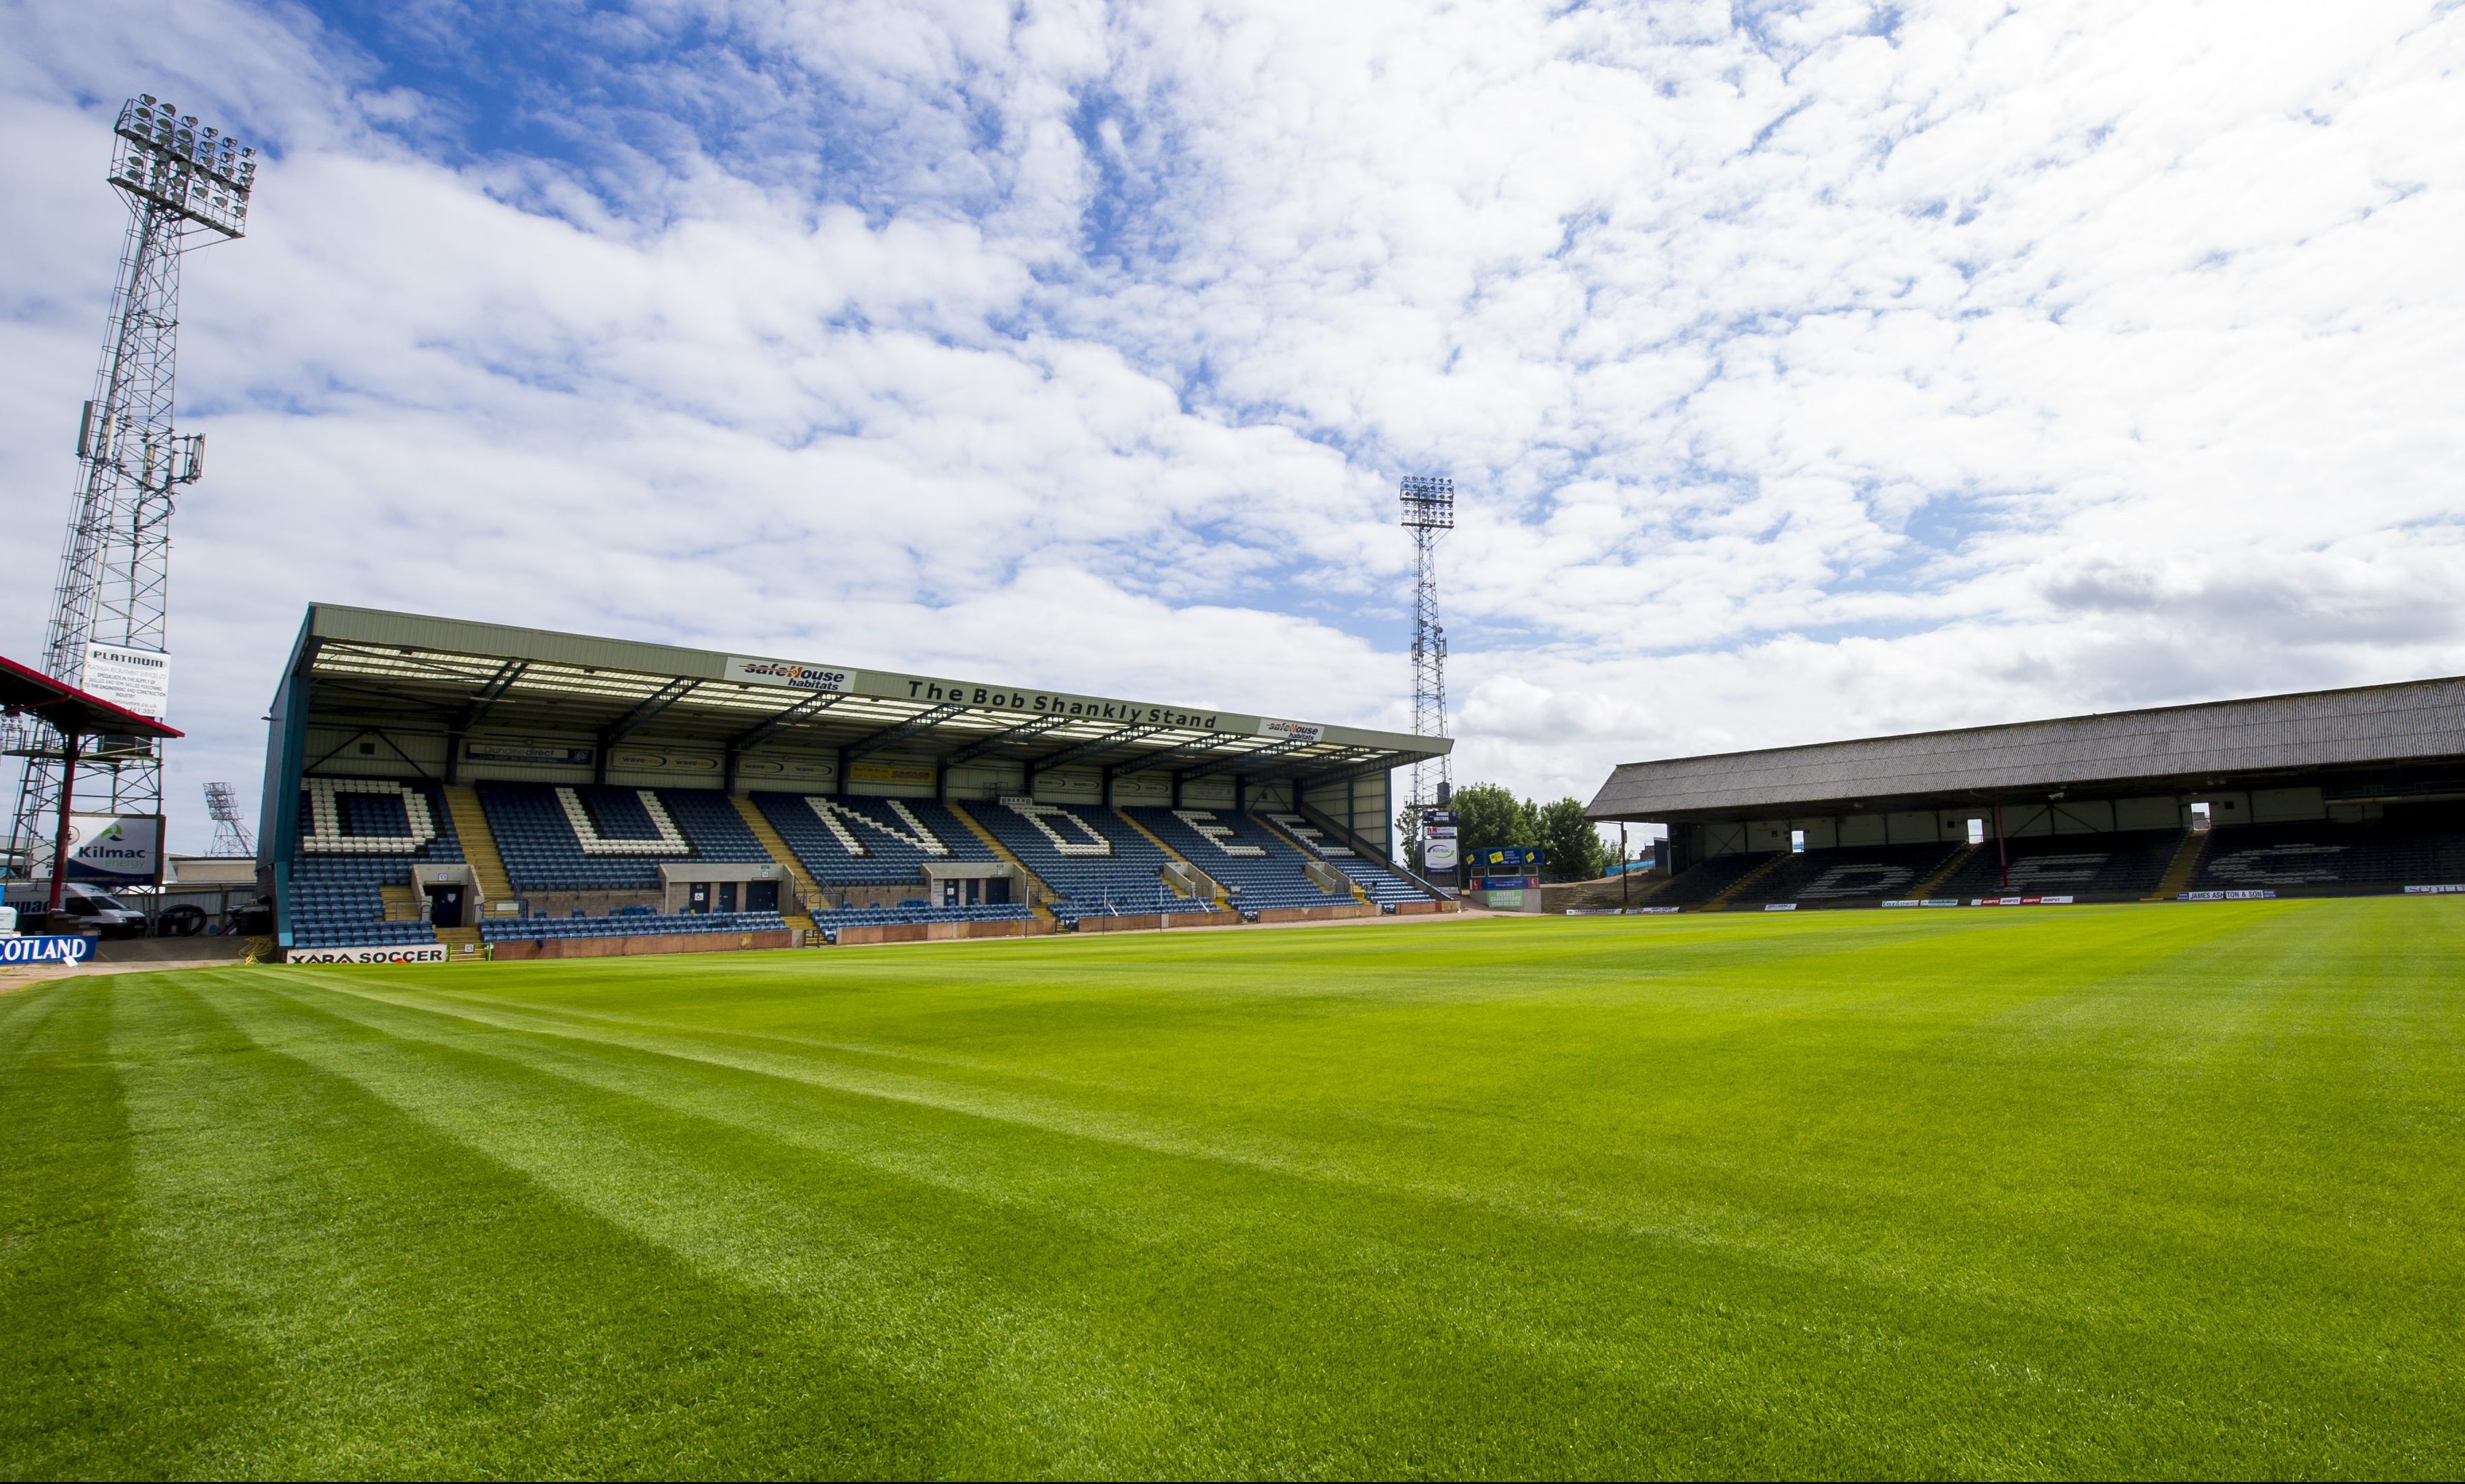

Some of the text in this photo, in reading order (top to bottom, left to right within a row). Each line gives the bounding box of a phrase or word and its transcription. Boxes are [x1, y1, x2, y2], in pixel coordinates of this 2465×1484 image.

[93, 651, 164, 668] PLATINUM
[788, 678, 839, 690] habitats
[908, 680, 1217, 729] The Bob Shankly Stand
[78, 846, 146, 858] Kilmac
[105, 859, 144, 868] energy
[359, 950, 442, 963] SOCCER
